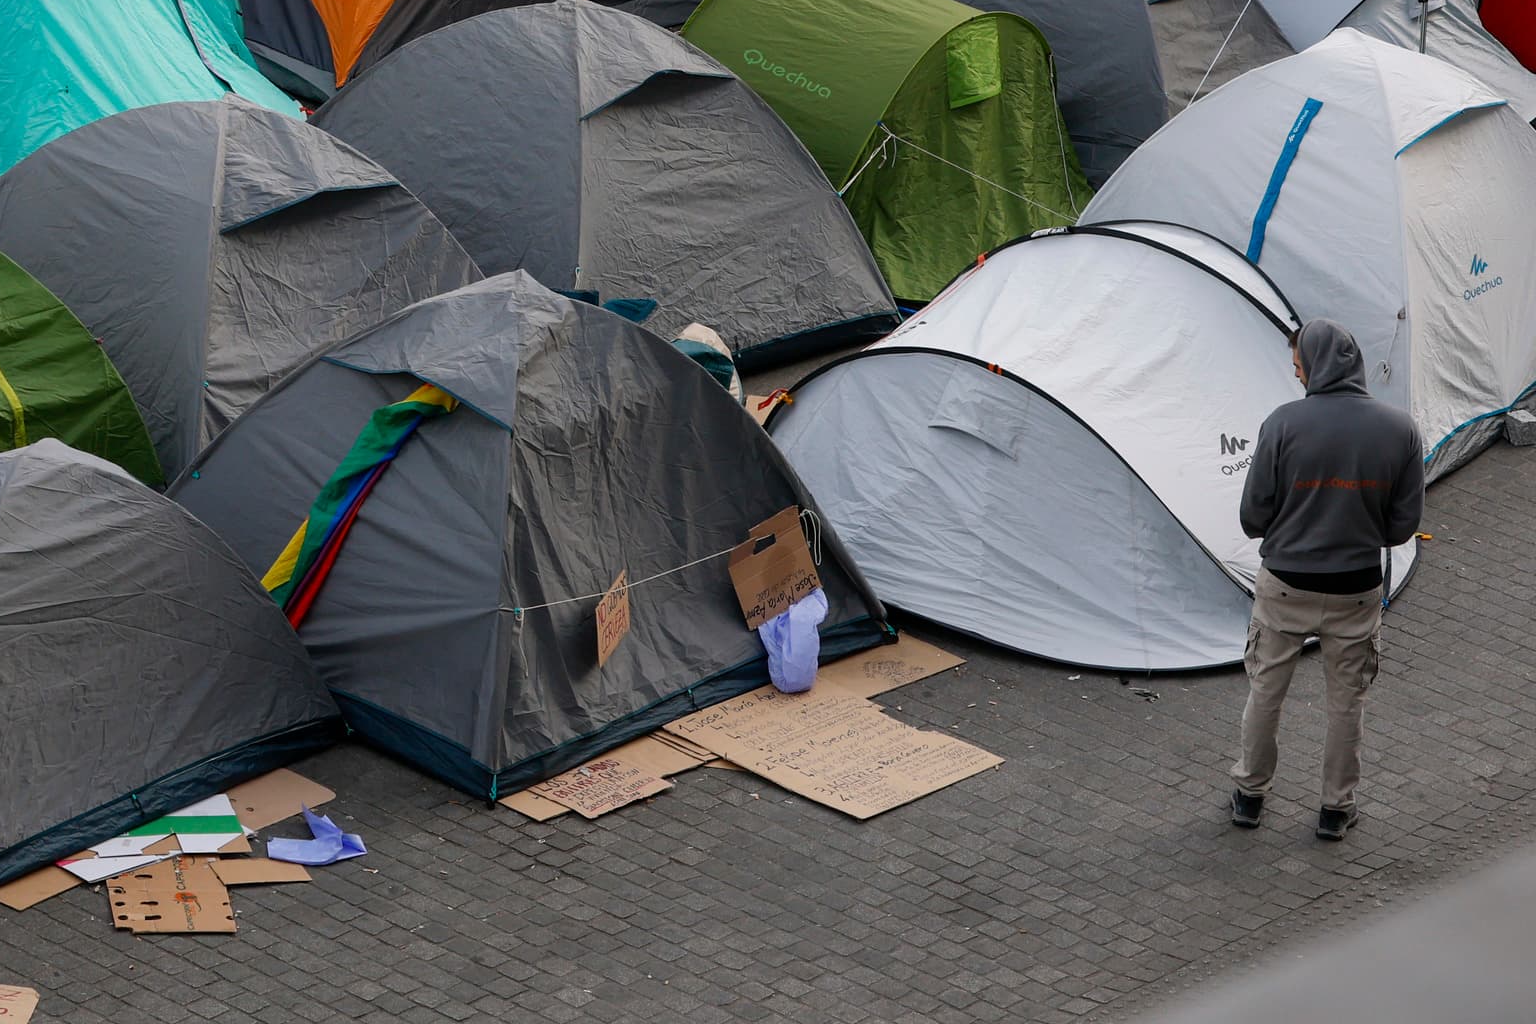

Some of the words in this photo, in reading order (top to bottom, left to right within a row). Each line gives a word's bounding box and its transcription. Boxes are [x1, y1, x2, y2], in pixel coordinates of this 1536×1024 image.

[743, 49, 832, 98] Quechua
[1463, 276, 1503, 301] Quechua
[1220, 454, 1255, 477] Quec
